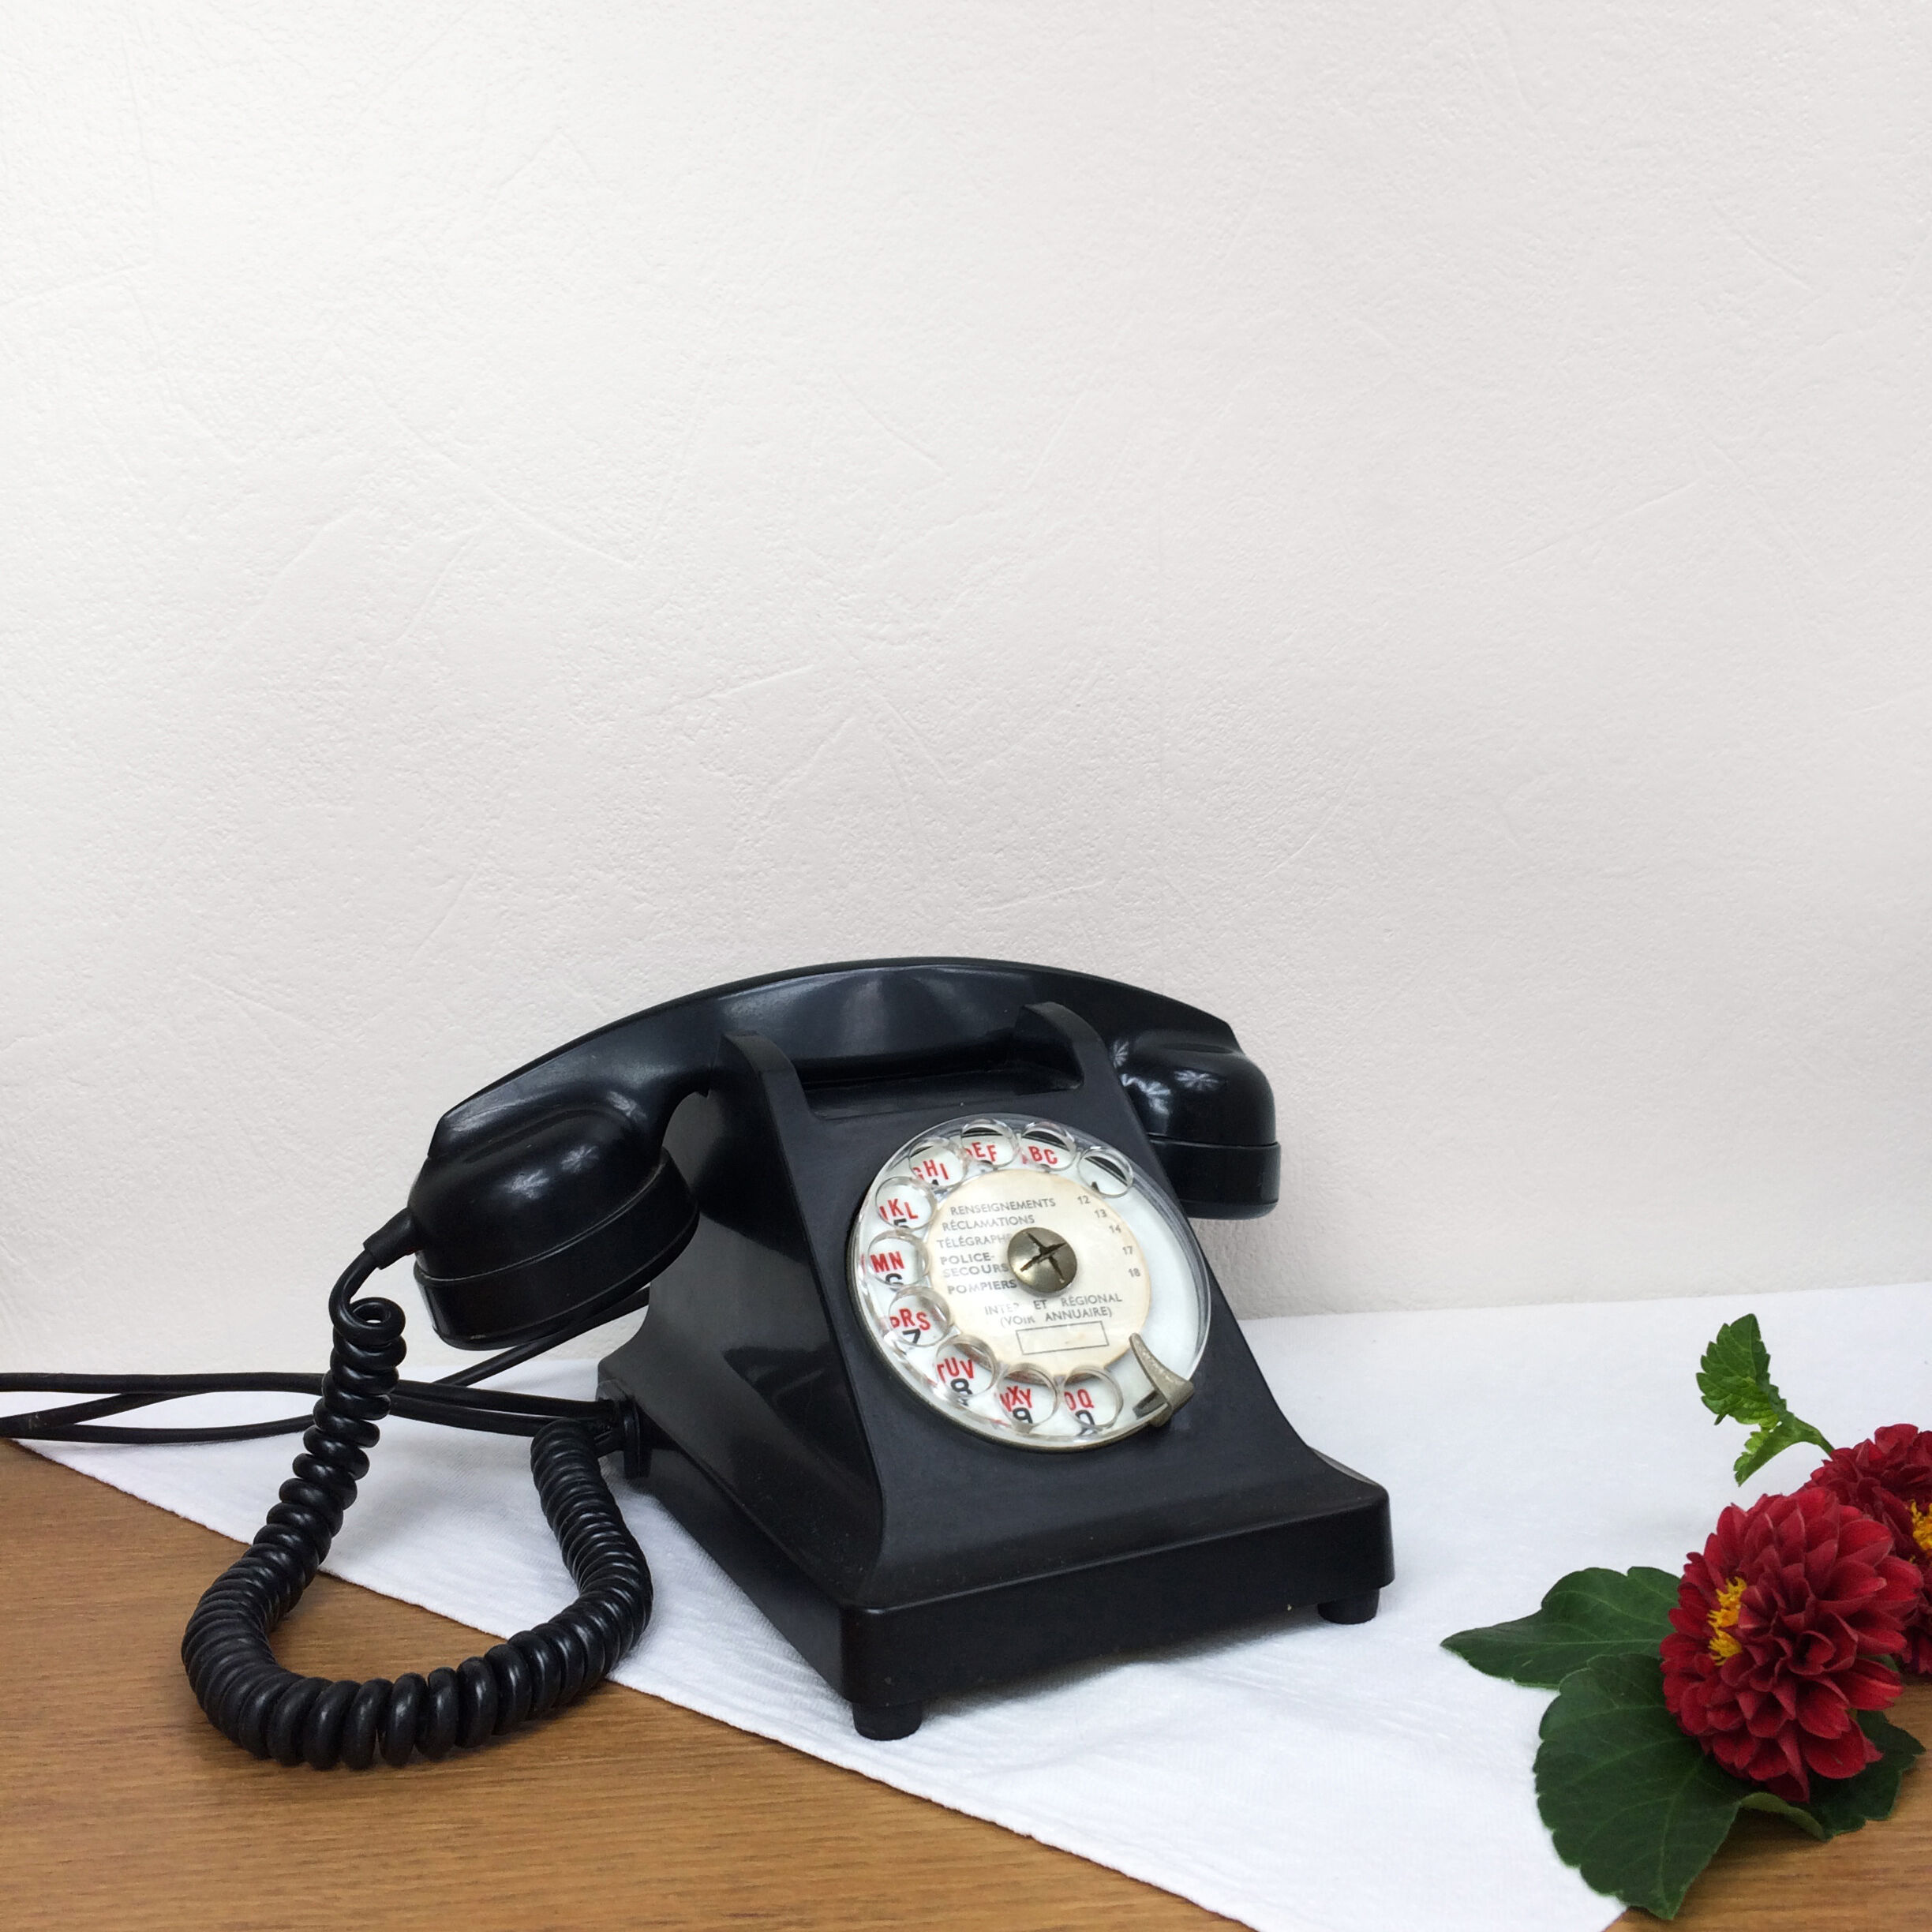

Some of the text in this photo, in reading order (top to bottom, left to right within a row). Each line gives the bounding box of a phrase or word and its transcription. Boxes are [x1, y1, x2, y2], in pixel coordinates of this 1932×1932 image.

[950, 1195, 1091, 1215] RENSEIGNEMENTS 12
[942, 1208, 1107, 1231] RÉCLAMATIONS 13
[1109, 1224, 1121, 1233] 14
[871, 1250, 905, 1273] MN
[940, 1252, 995, 1265] POLICE-
[942, 1245, 1133, 1278] SECOURS 17
[947, 1267, 1141, 1295] POMPIERS 18
[1033, 1299, 1047, 1310] ET
[1061, 1293, 1122, 1307] RÉGIONAL
[1045, 1306, 1113, 1322] ANNUAIRE)
